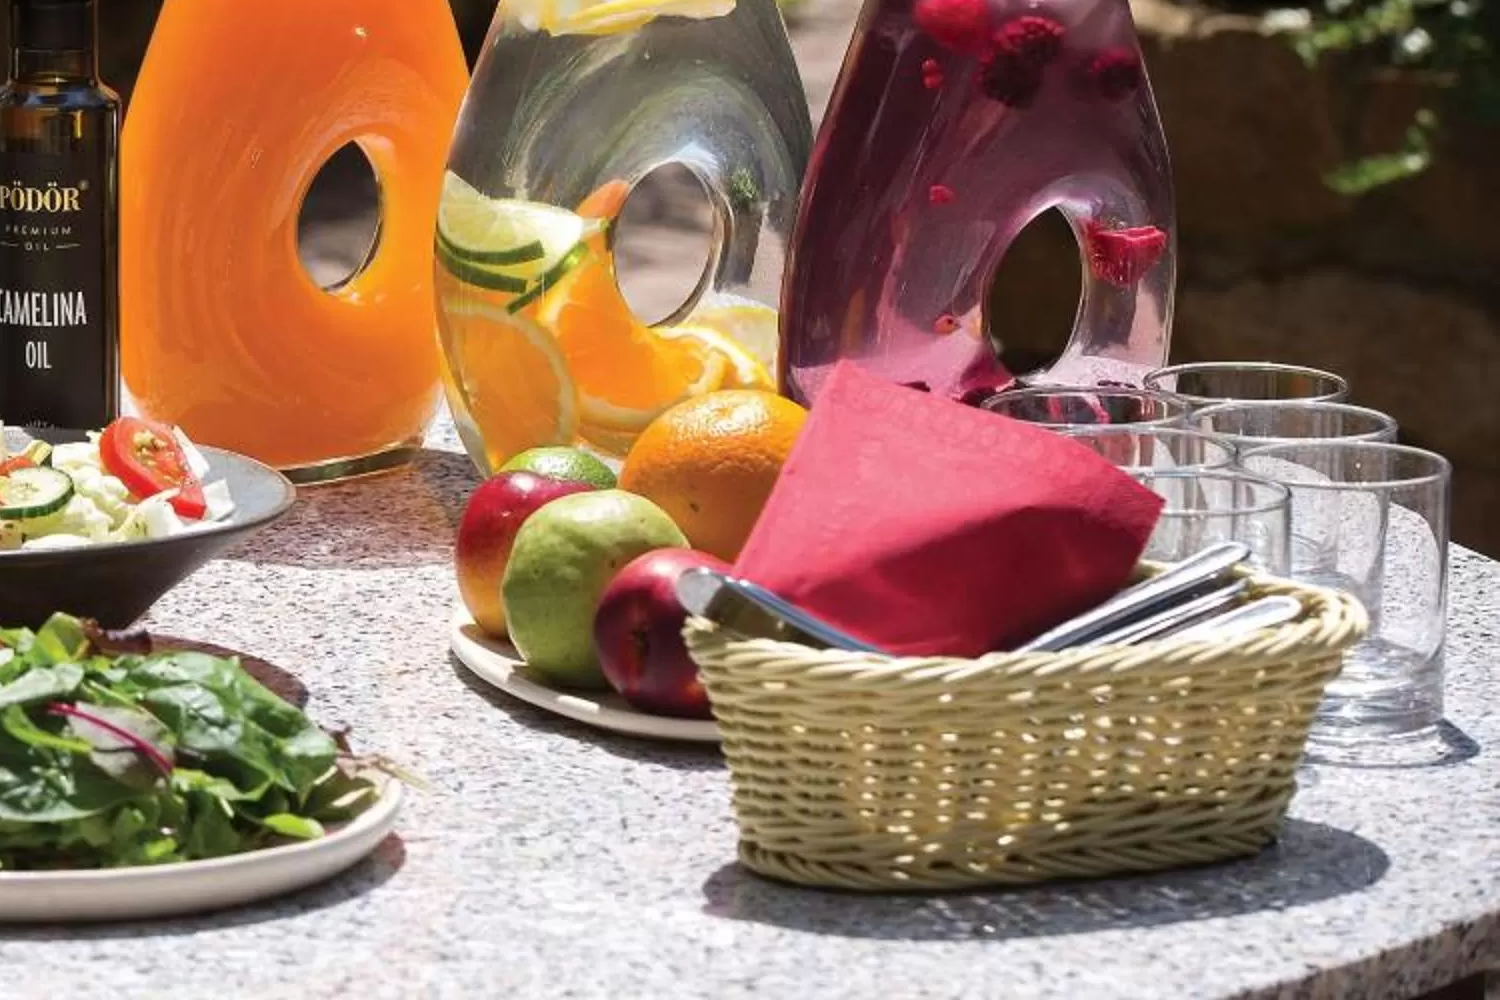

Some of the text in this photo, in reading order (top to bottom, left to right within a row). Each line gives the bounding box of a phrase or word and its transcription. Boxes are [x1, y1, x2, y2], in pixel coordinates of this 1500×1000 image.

[5, 224, 71, 235] PREMIUM
[24, 242, 49, 251] OIL
[25, 341, 52, 369] OIL
